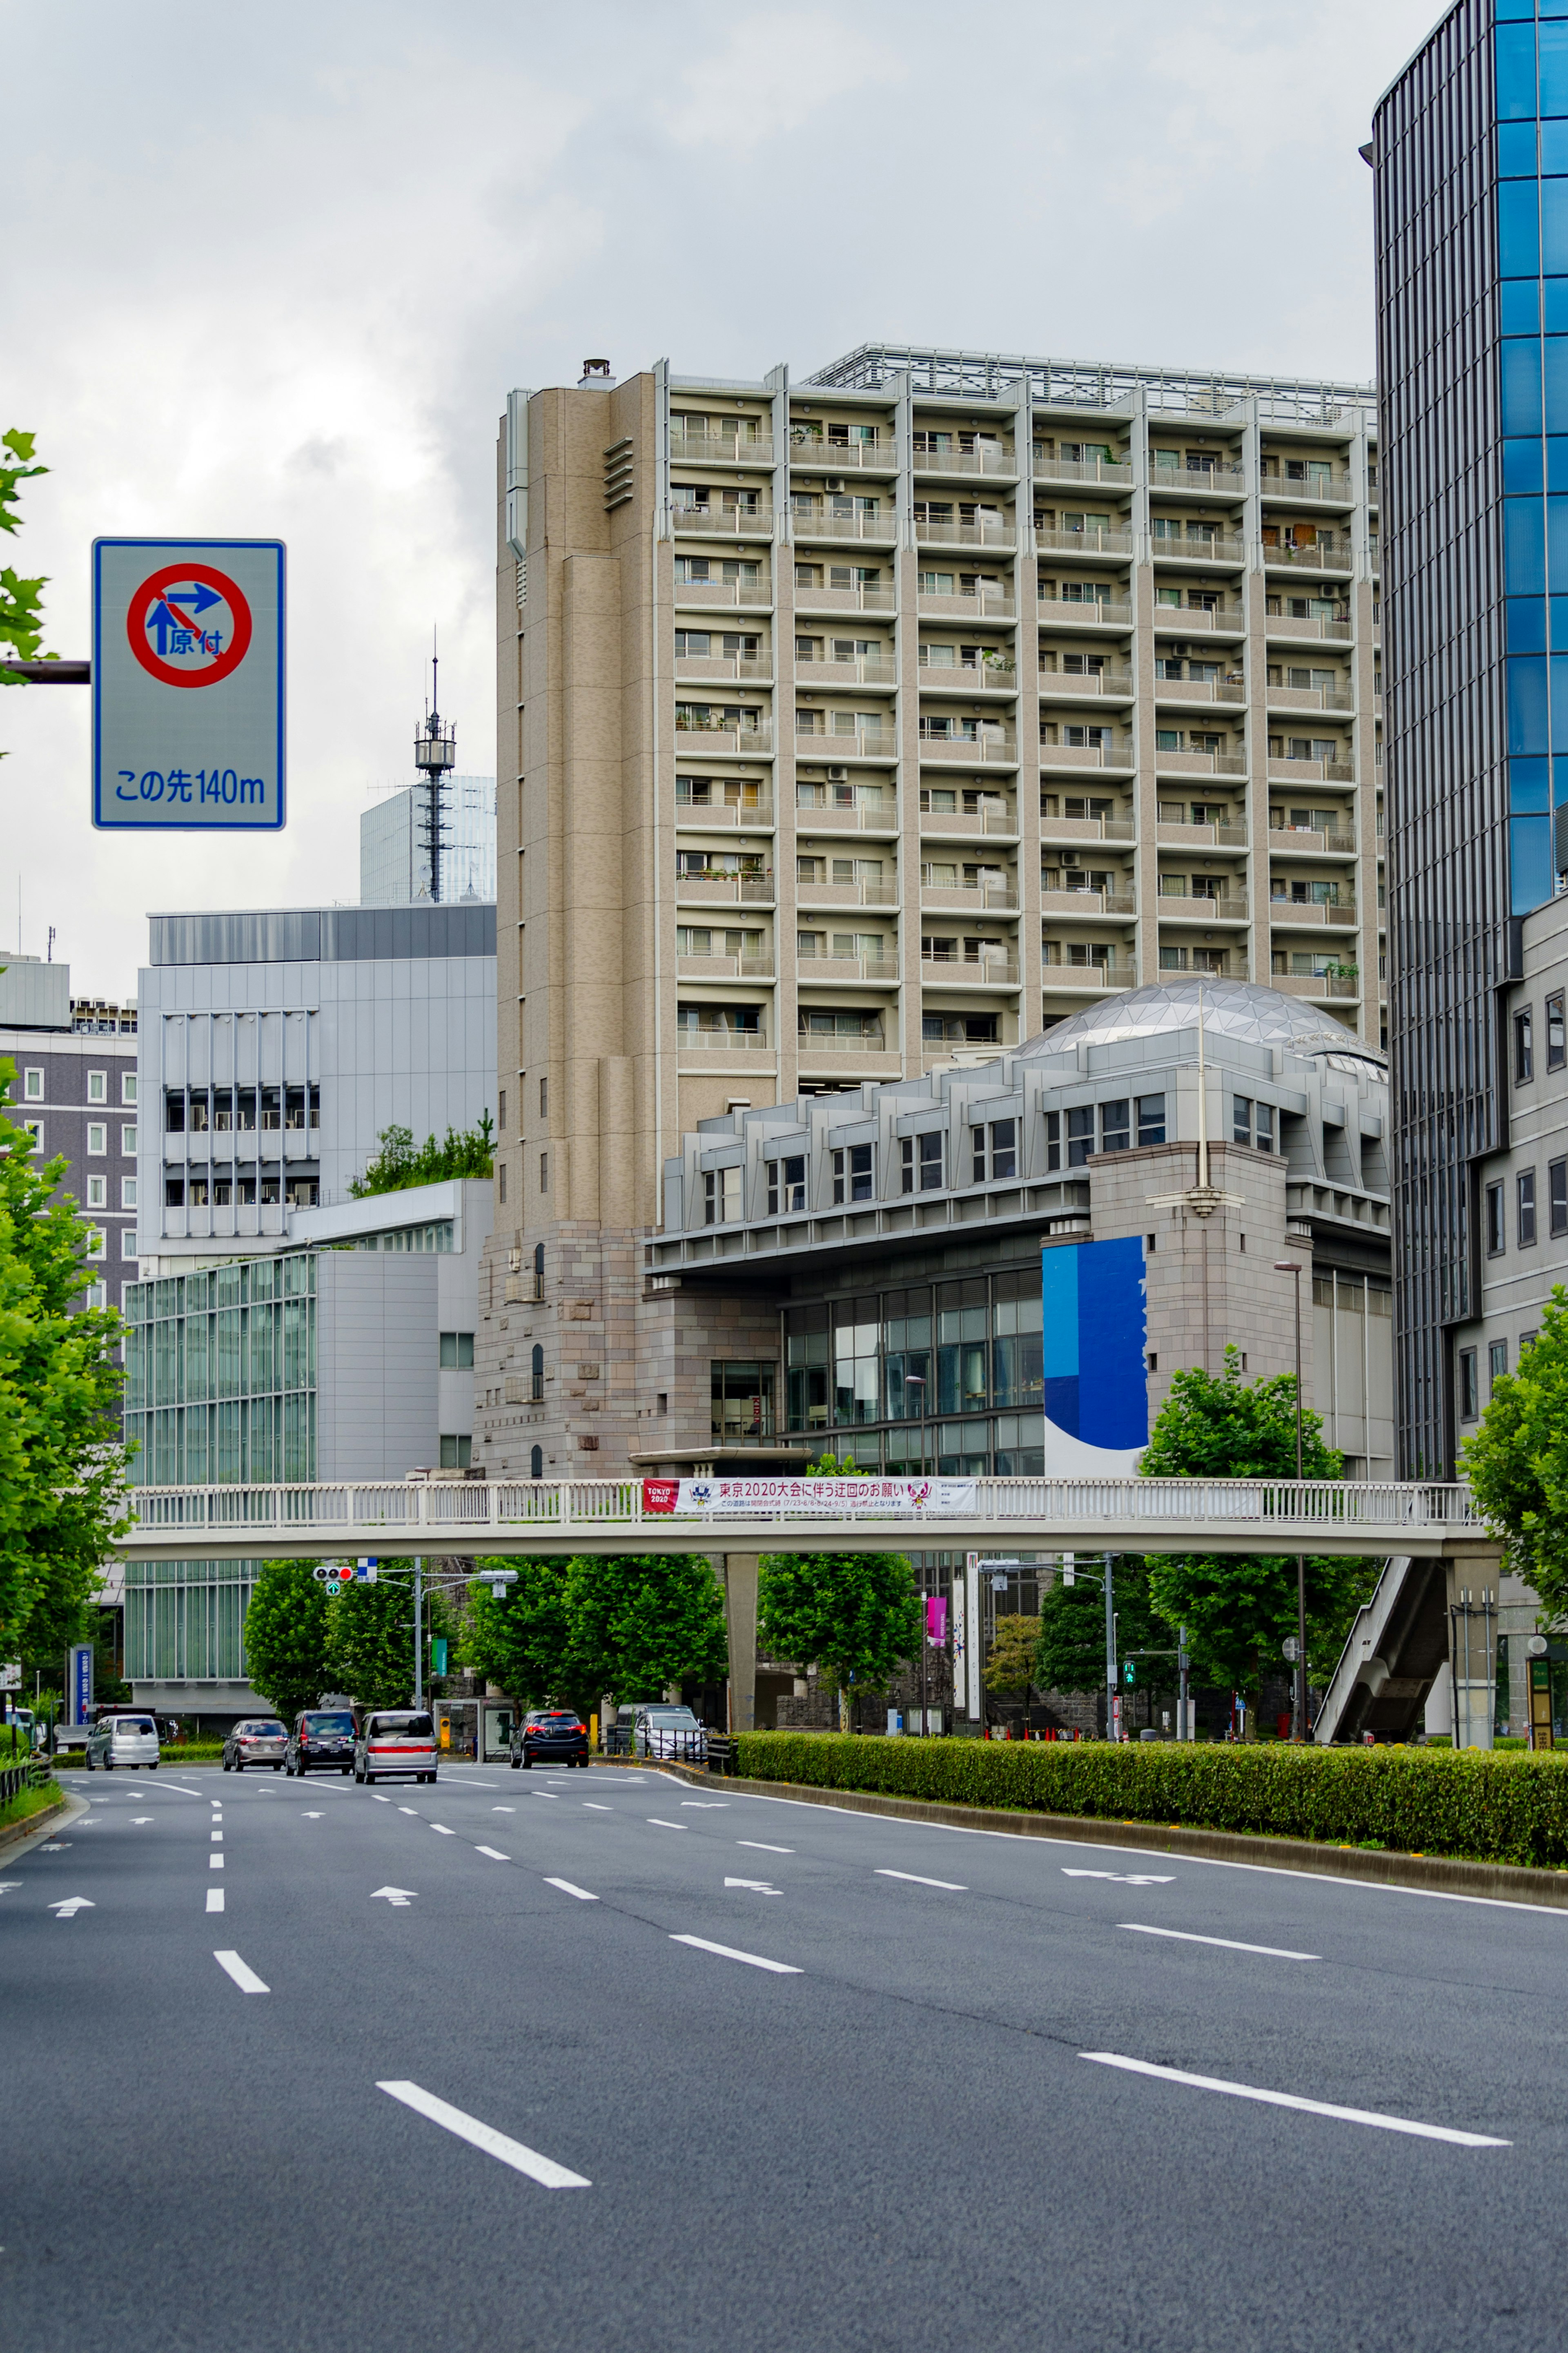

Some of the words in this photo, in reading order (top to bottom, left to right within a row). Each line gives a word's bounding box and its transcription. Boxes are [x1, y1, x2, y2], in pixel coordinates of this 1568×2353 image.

[169, 629, 223, 655] 原付
[116, 769, 265, 804] この先140m
[719, 1482, 904, 1498] 東京2020大会に伴う迂回のお願い
